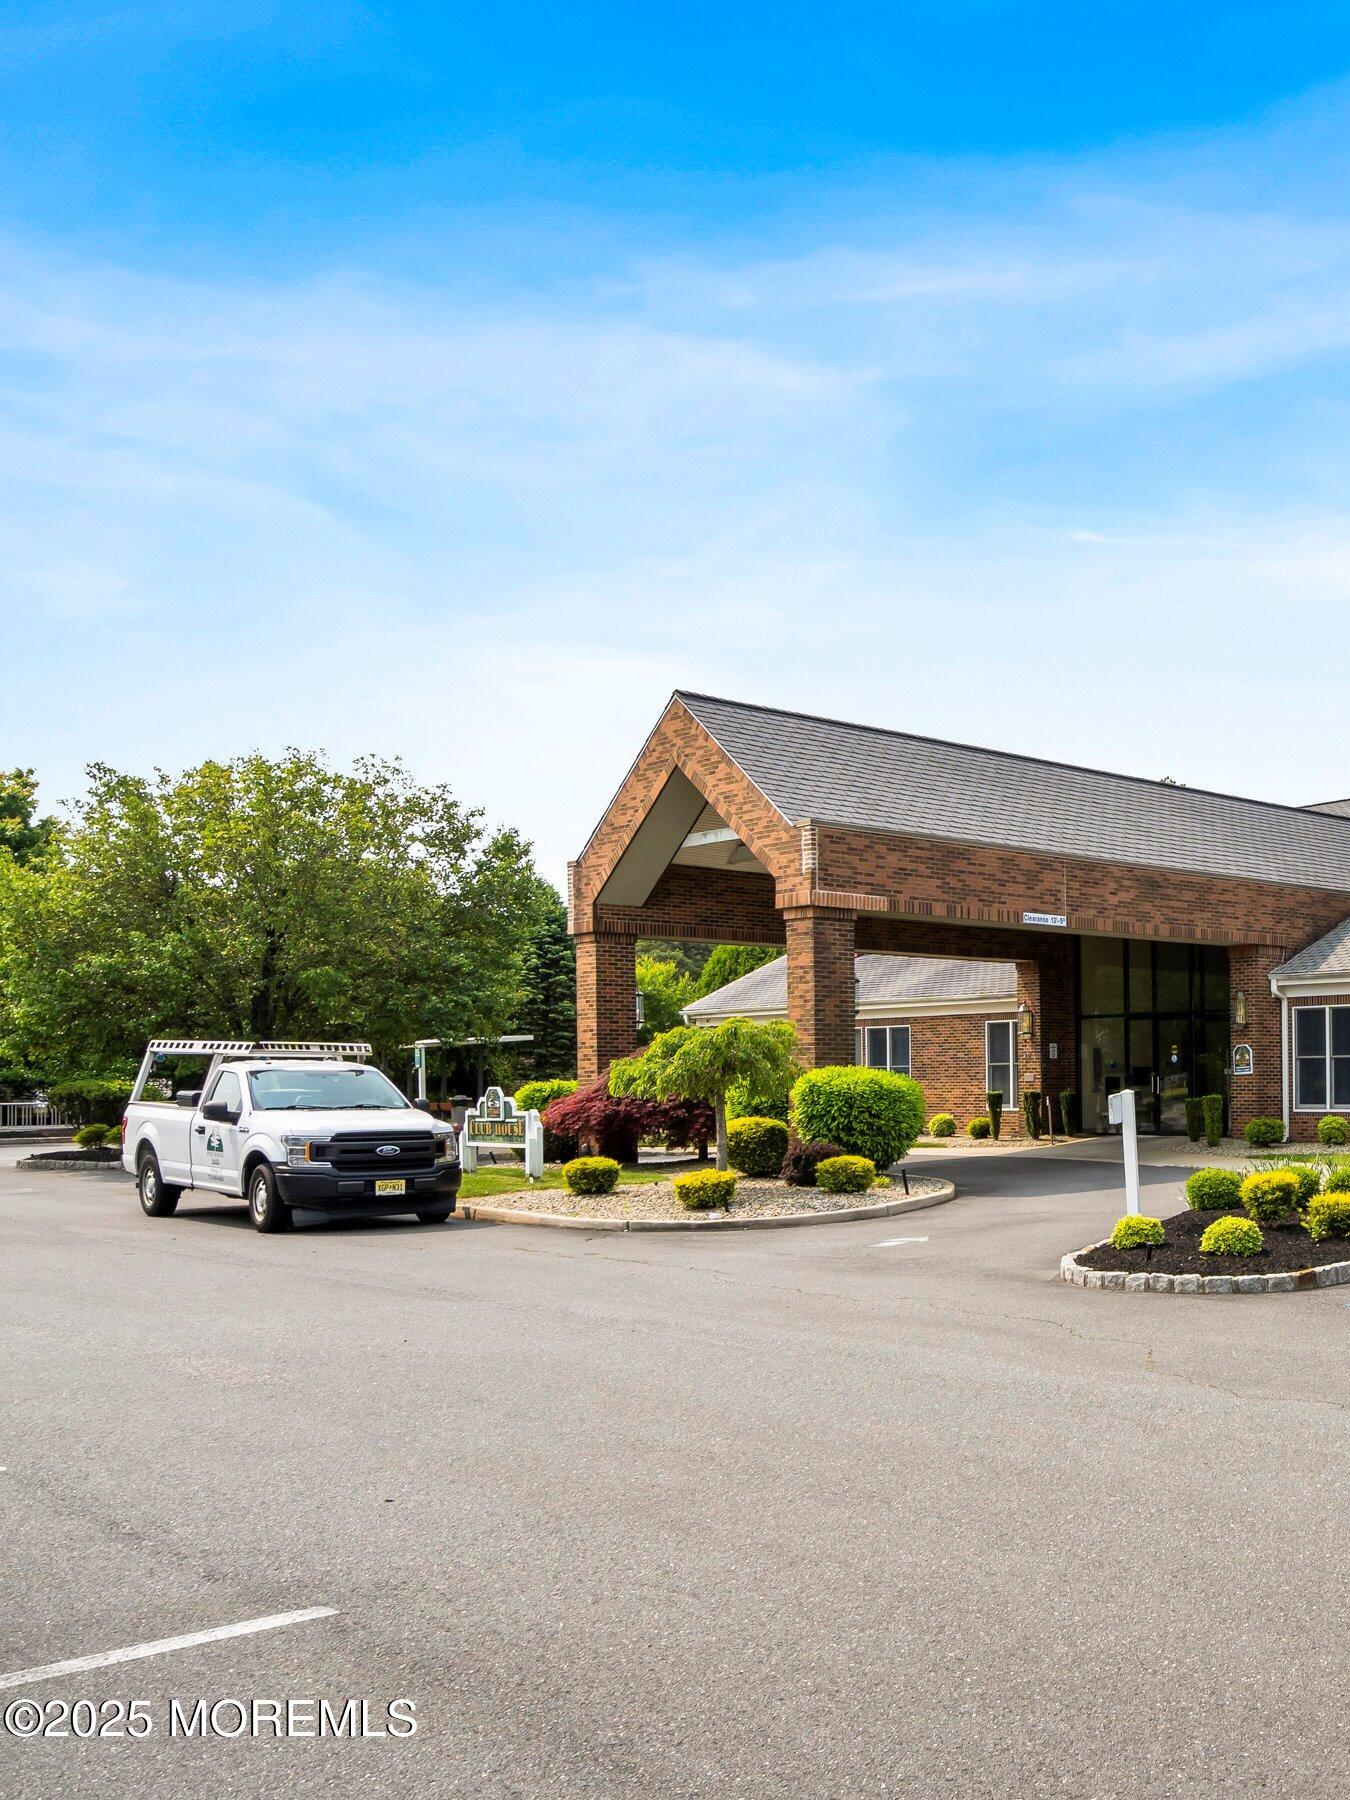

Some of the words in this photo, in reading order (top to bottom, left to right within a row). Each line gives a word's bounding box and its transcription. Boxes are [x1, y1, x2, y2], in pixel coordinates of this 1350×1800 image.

[1024, 914, 1049, 923] Clearance
[469, 1119, 492, 1136] CLUB
[495, 1119, 524, 1137] HOUSE
